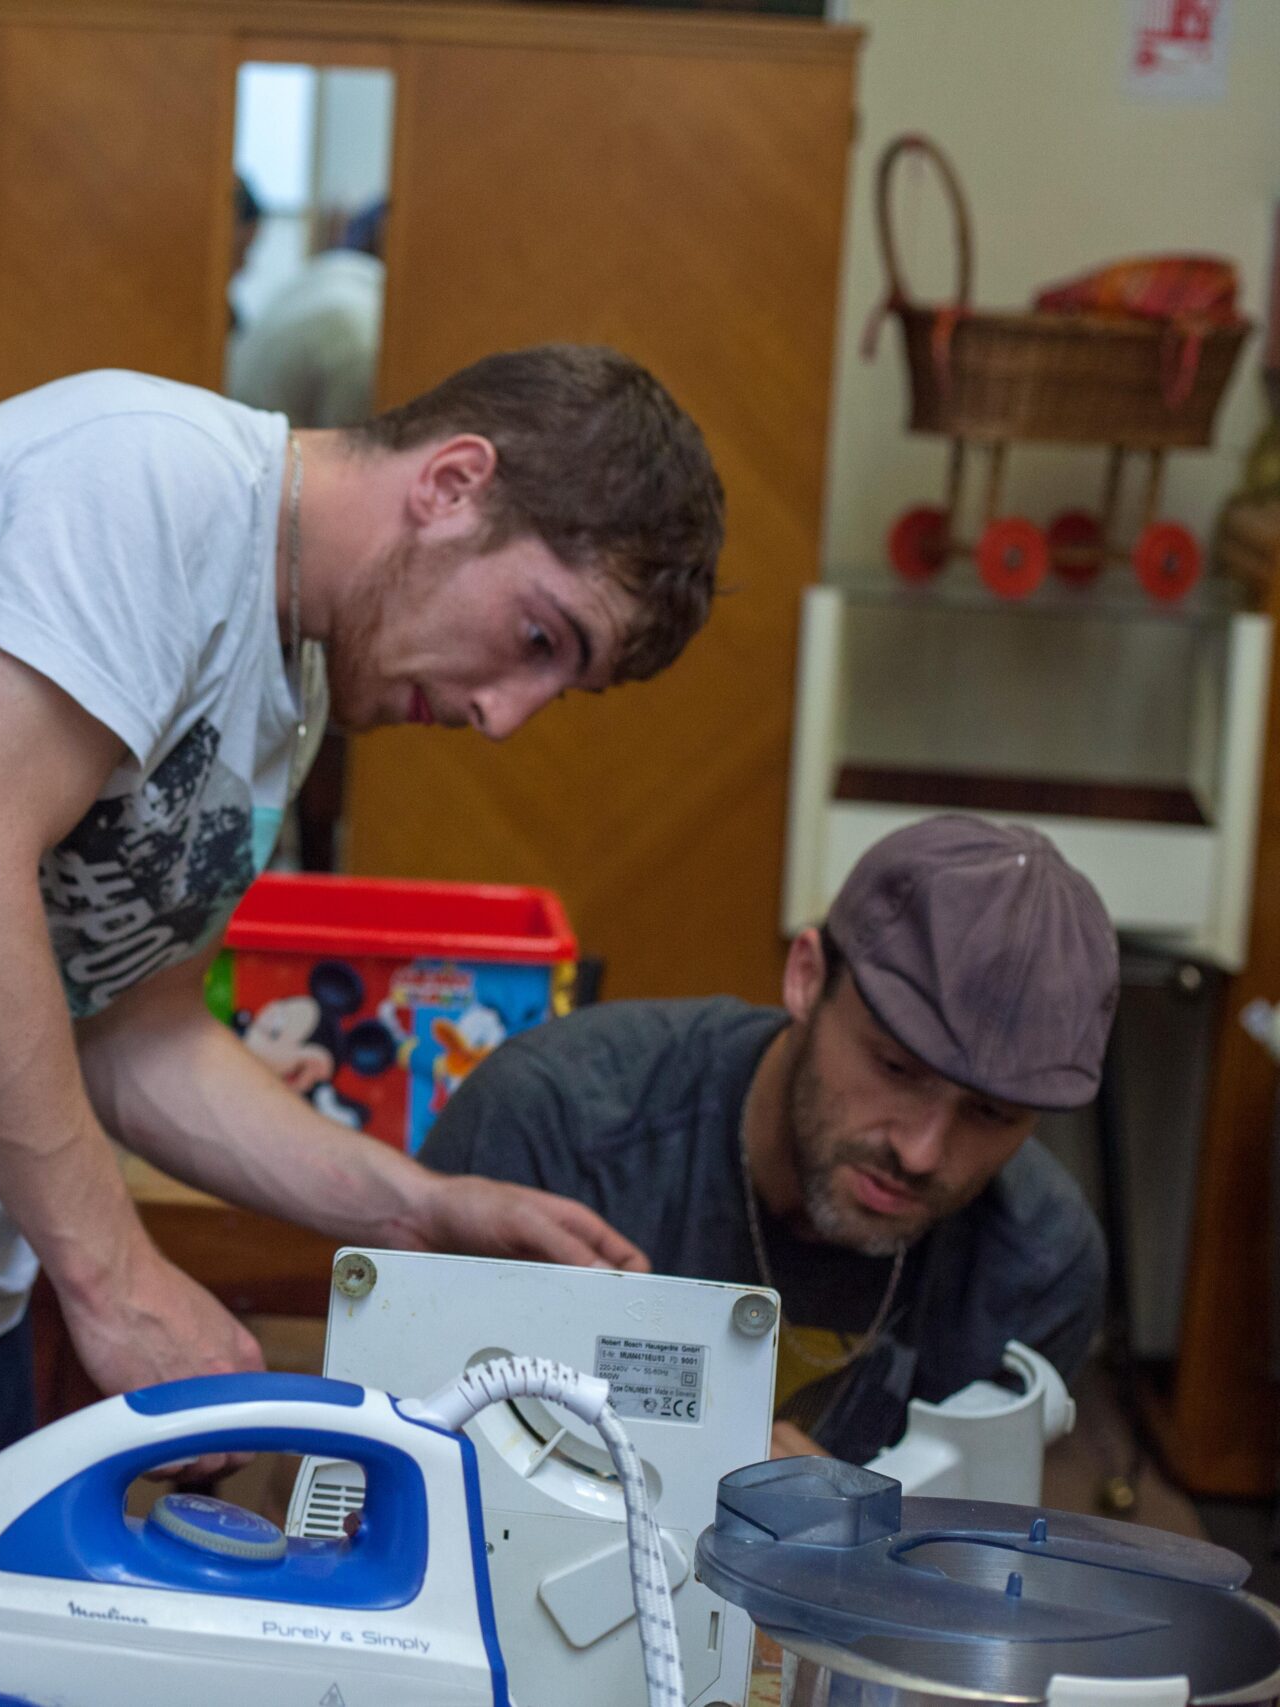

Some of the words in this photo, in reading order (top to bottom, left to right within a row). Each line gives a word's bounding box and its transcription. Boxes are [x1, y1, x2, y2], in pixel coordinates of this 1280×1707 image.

[601, 1338, 621, 1346] Robert
[624, 1340, 643, 1348] Bosch
[681, 1345, 700, 1353] GmbH
[262, 1621, 331, 1642] Purely
[340, 1631, 353, 1642] &
[362, 1631, 431, 1654] Simply
